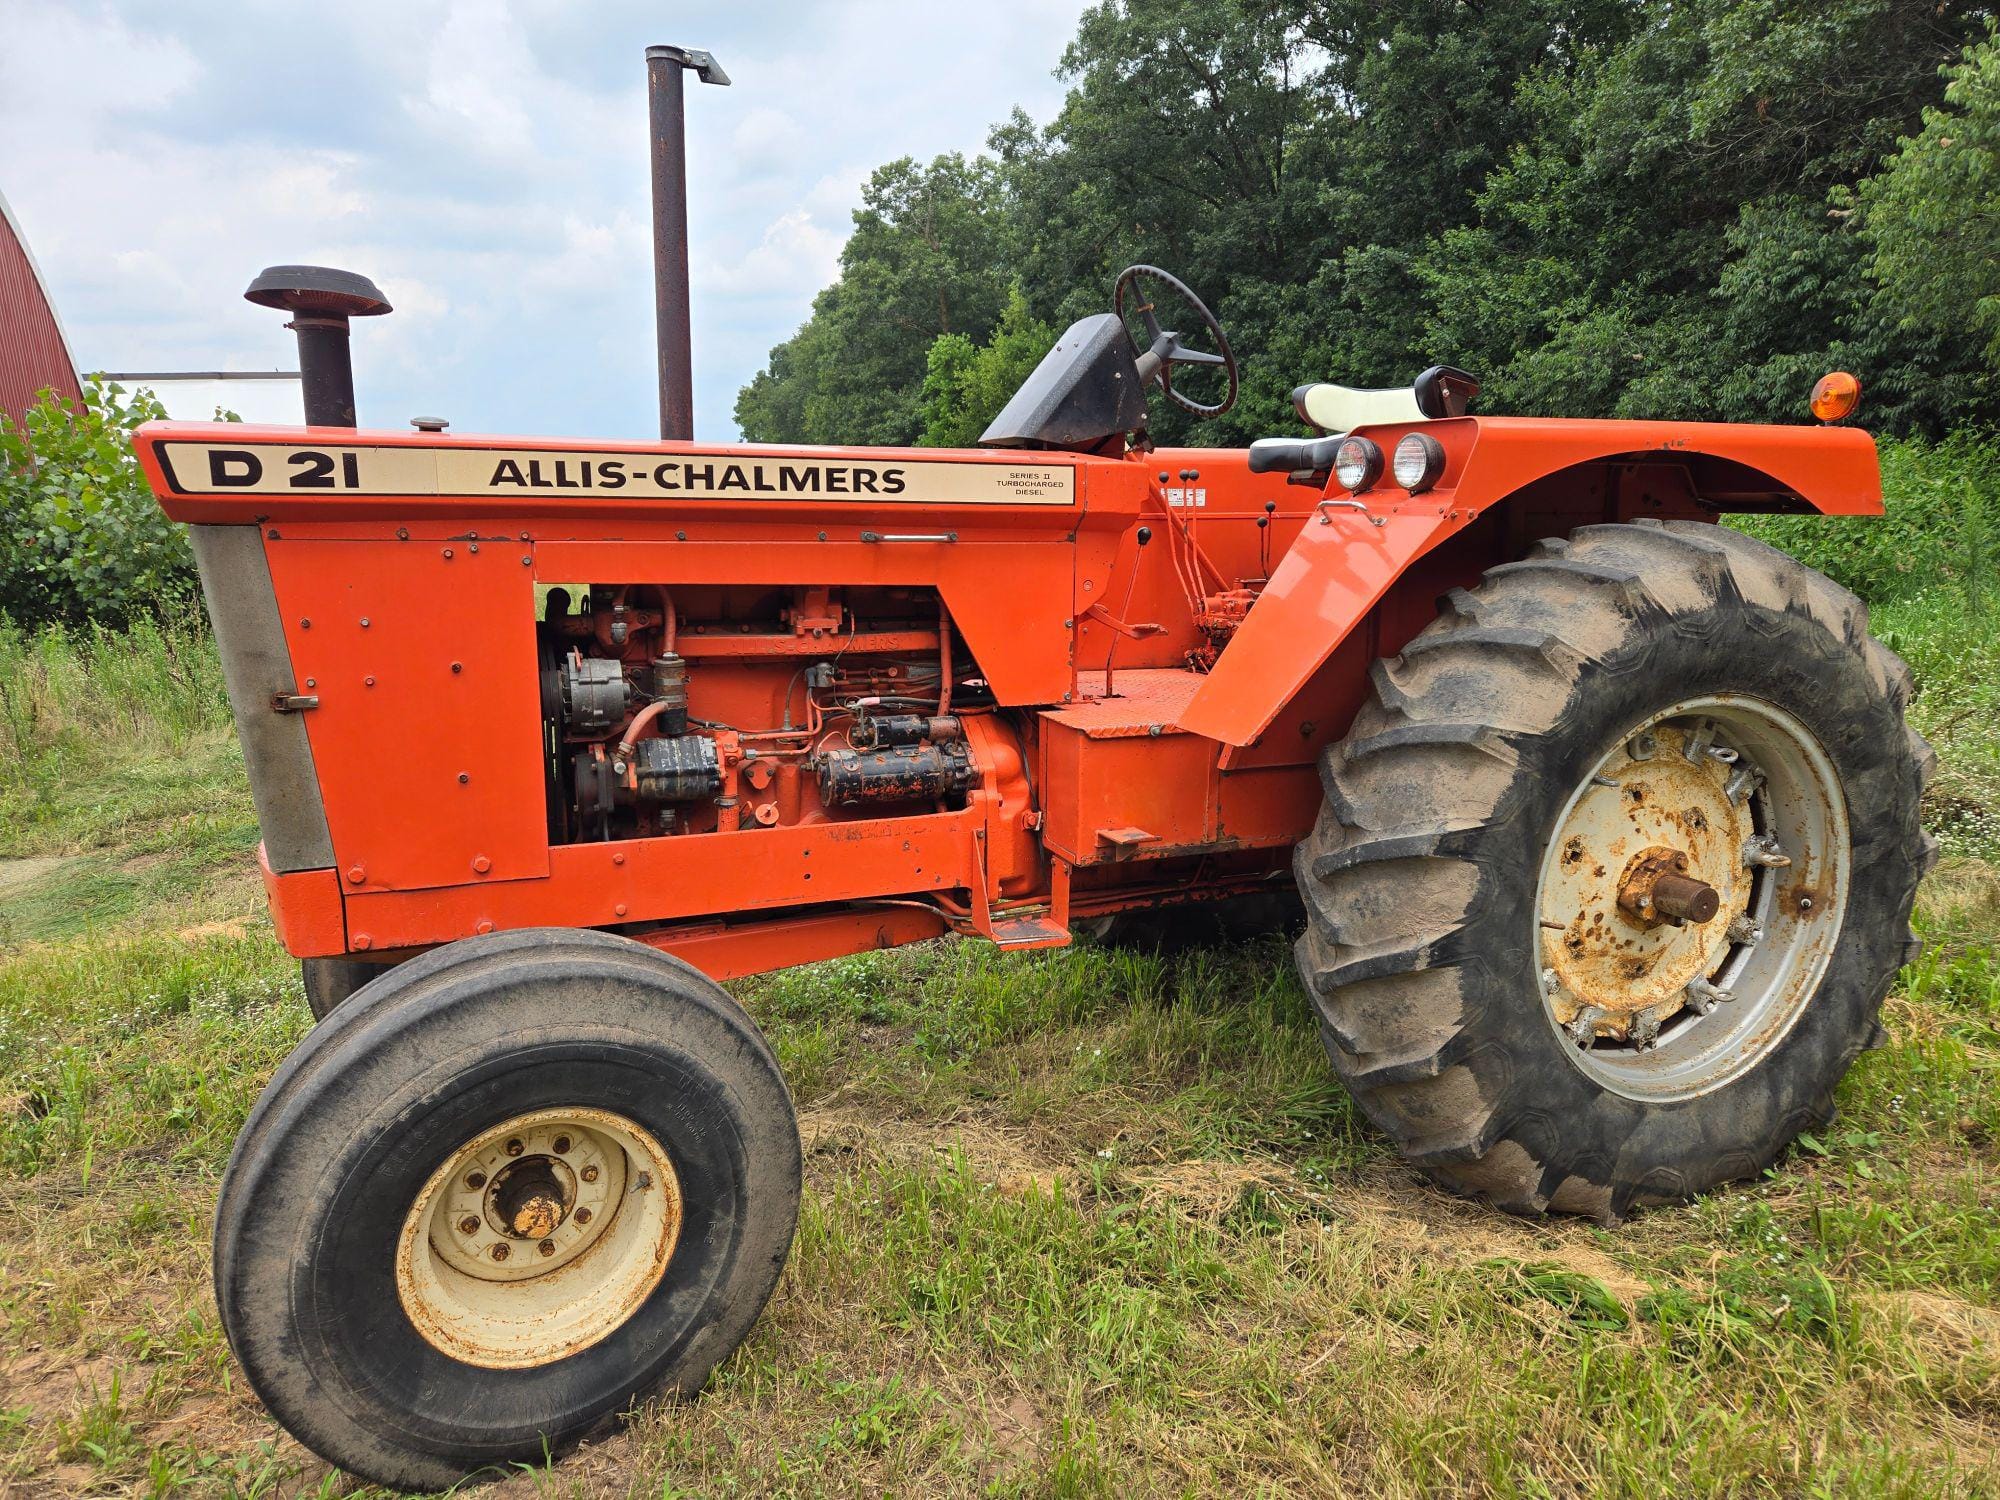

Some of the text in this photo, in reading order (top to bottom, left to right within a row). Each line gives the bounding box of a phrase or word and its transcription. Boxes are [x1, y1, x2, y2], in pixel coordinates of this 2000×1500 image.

[208, 449, 360, 488] D 21
[489, 459, 906, 494] ALLIS-CHALMERS
[1009, 472, 1040, 480] SERIES
[996, 480, 1064, 488] TURBOCHARGED
